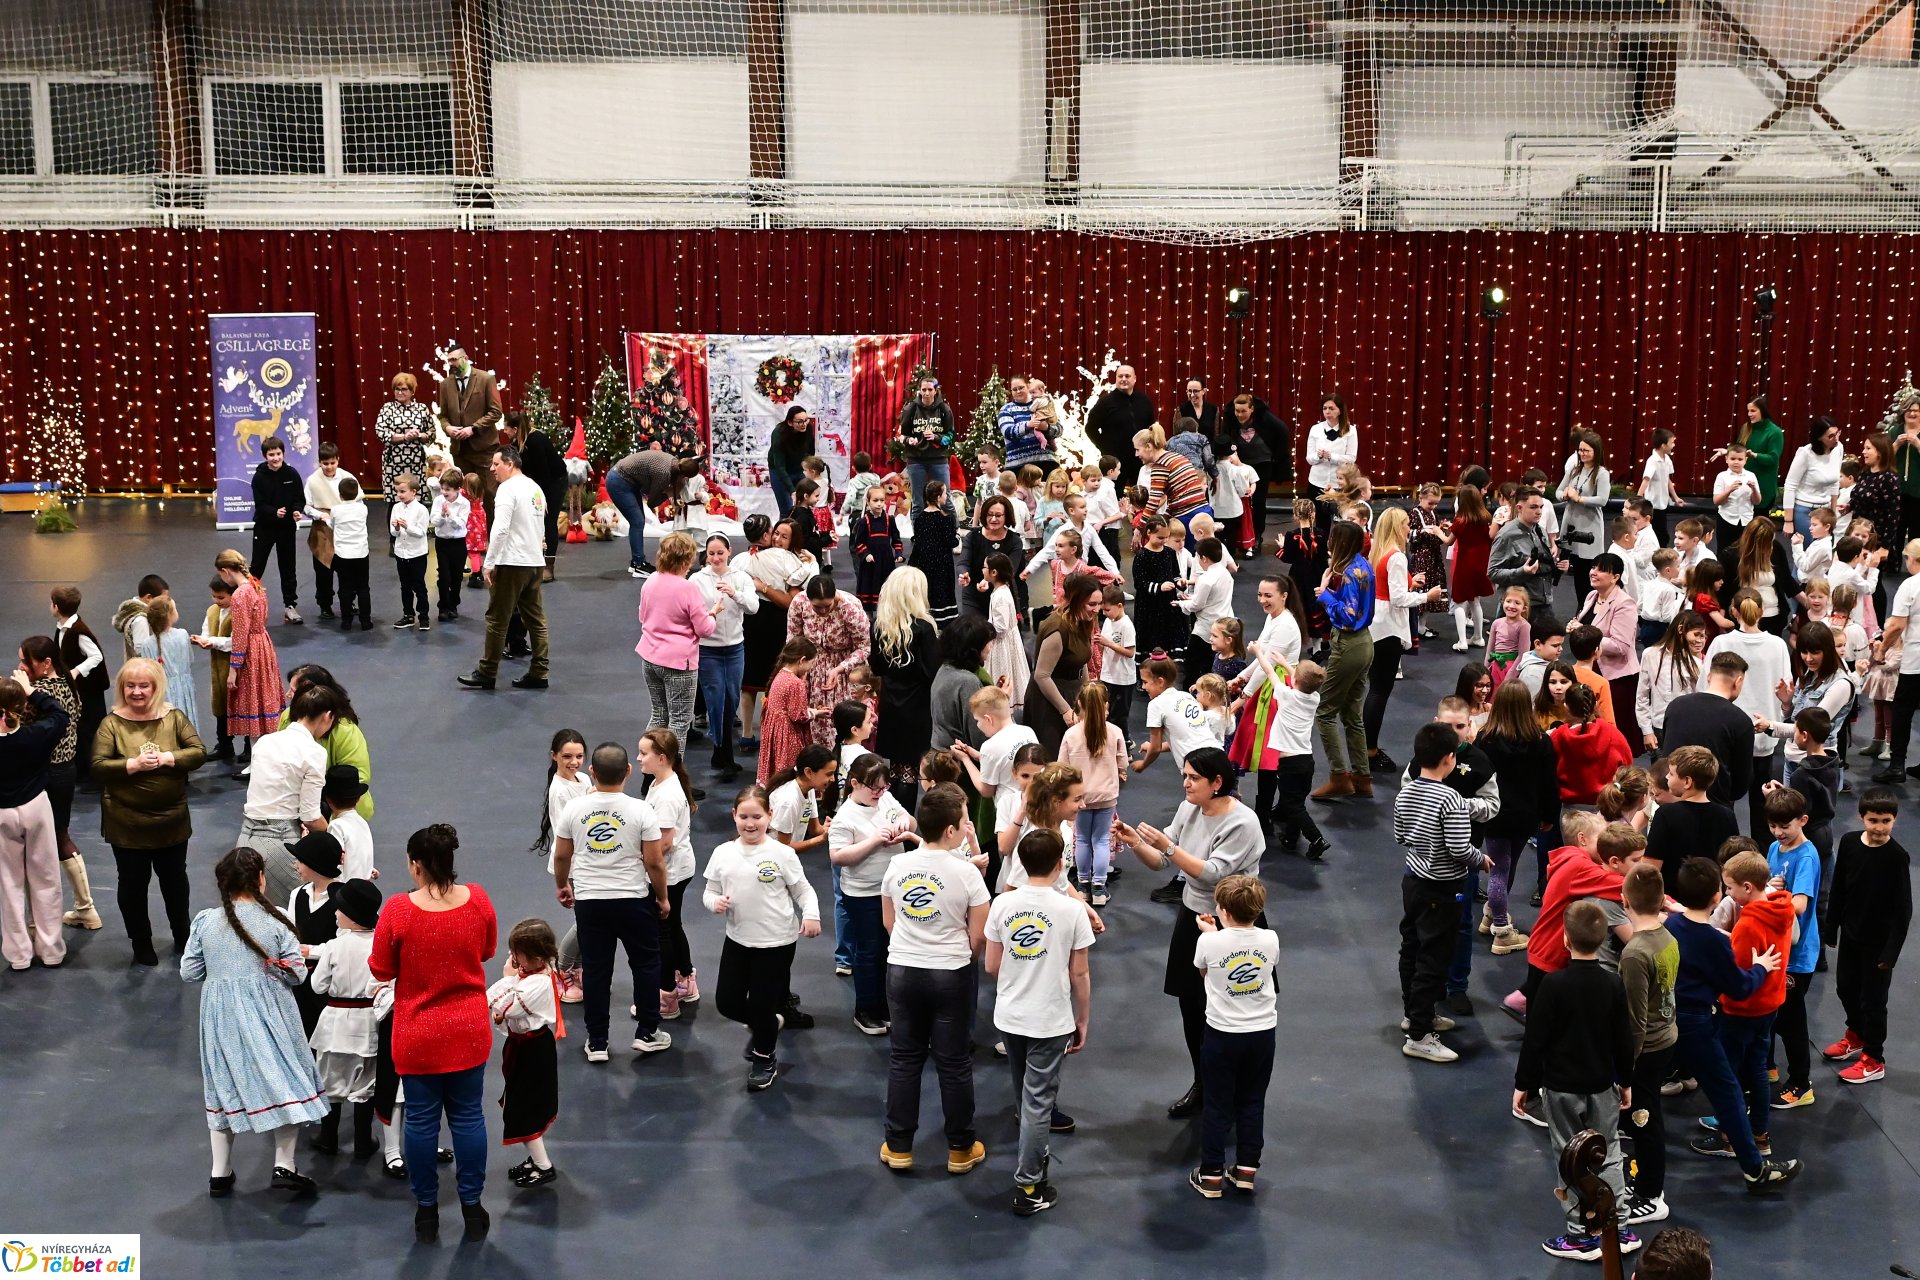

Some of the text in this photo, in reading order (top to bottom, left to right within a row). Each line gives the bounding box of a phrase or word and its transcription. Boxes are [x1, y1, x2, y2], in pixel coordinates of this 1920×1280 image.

[216, 339, 311, 352] CSILLAGREGE
[220, 404, 254, 414] Advent
[1185, 704, 1199, 719] GG
[580, 810, 626, 826] Gárdonyi Géza
[587, 822, 617, 841] GG
[585, 841, 623, 854] Tagintézmény
[759, 867, 775, 876] GG
[897, 872, 944, 890] Gárdonyi Géza
[903, 886, 935, 907] GG
[1004, 910, 1053, 928] Gárdonyi Géza
[1011, 925, 1044, 947] GG
[1008, 946, 1048, 960] Tagintézmény
[1219, 949, 1268, 968] Gárdonyi Géza
[1228, 963, 1260, 984] GG
